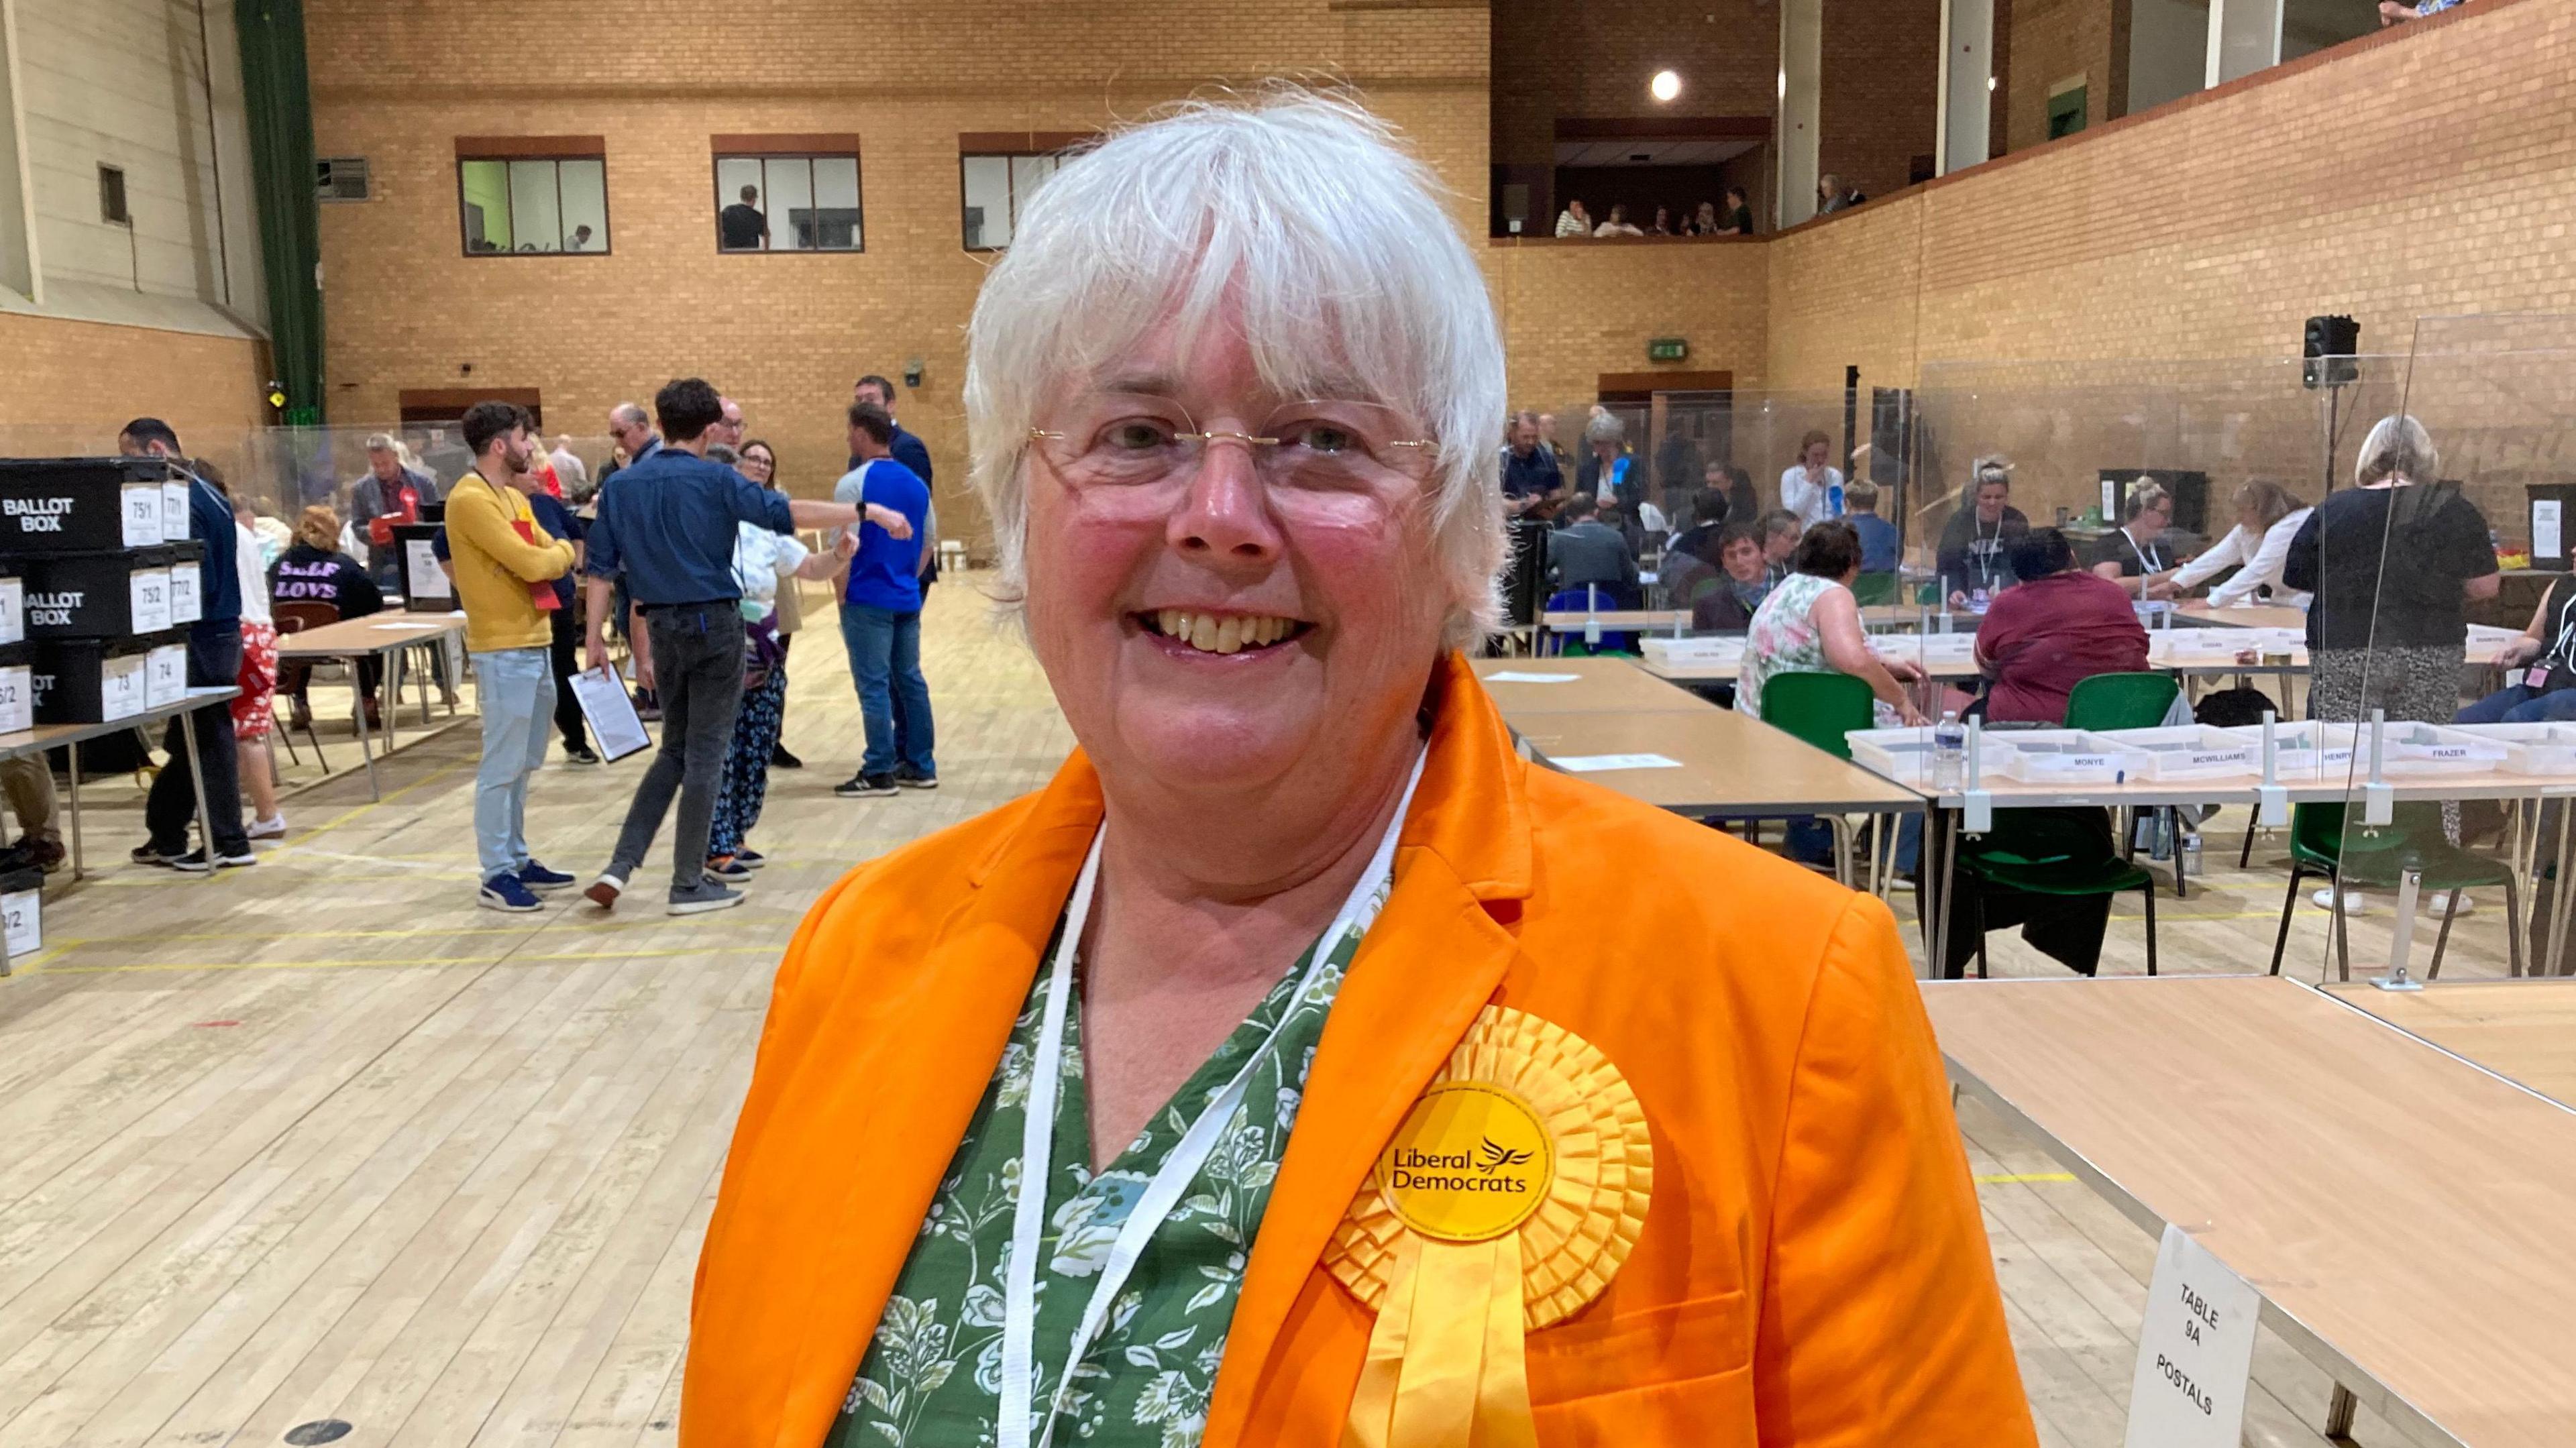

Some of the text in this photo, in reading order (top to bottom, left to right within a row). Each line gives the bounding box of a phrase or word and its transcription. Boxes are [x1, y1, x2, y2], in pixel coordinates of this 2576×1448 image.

[2, 498, 73, 515] BALLOT
[20, 516, 62, 532] BOX
[31, 610, 71, 625] BOX
[2432, 749, 2467, 757] FRAZER
[1394, 1148, 1470, 1169] Liberal
[1393, 1170, 1526, 1192] Democrats
[2182, 1283, 2219, 1331] TABLE
[2185, 1320, 2200, 1347] 9A
[2157, 1353, 2212, 1416] POSTALS
